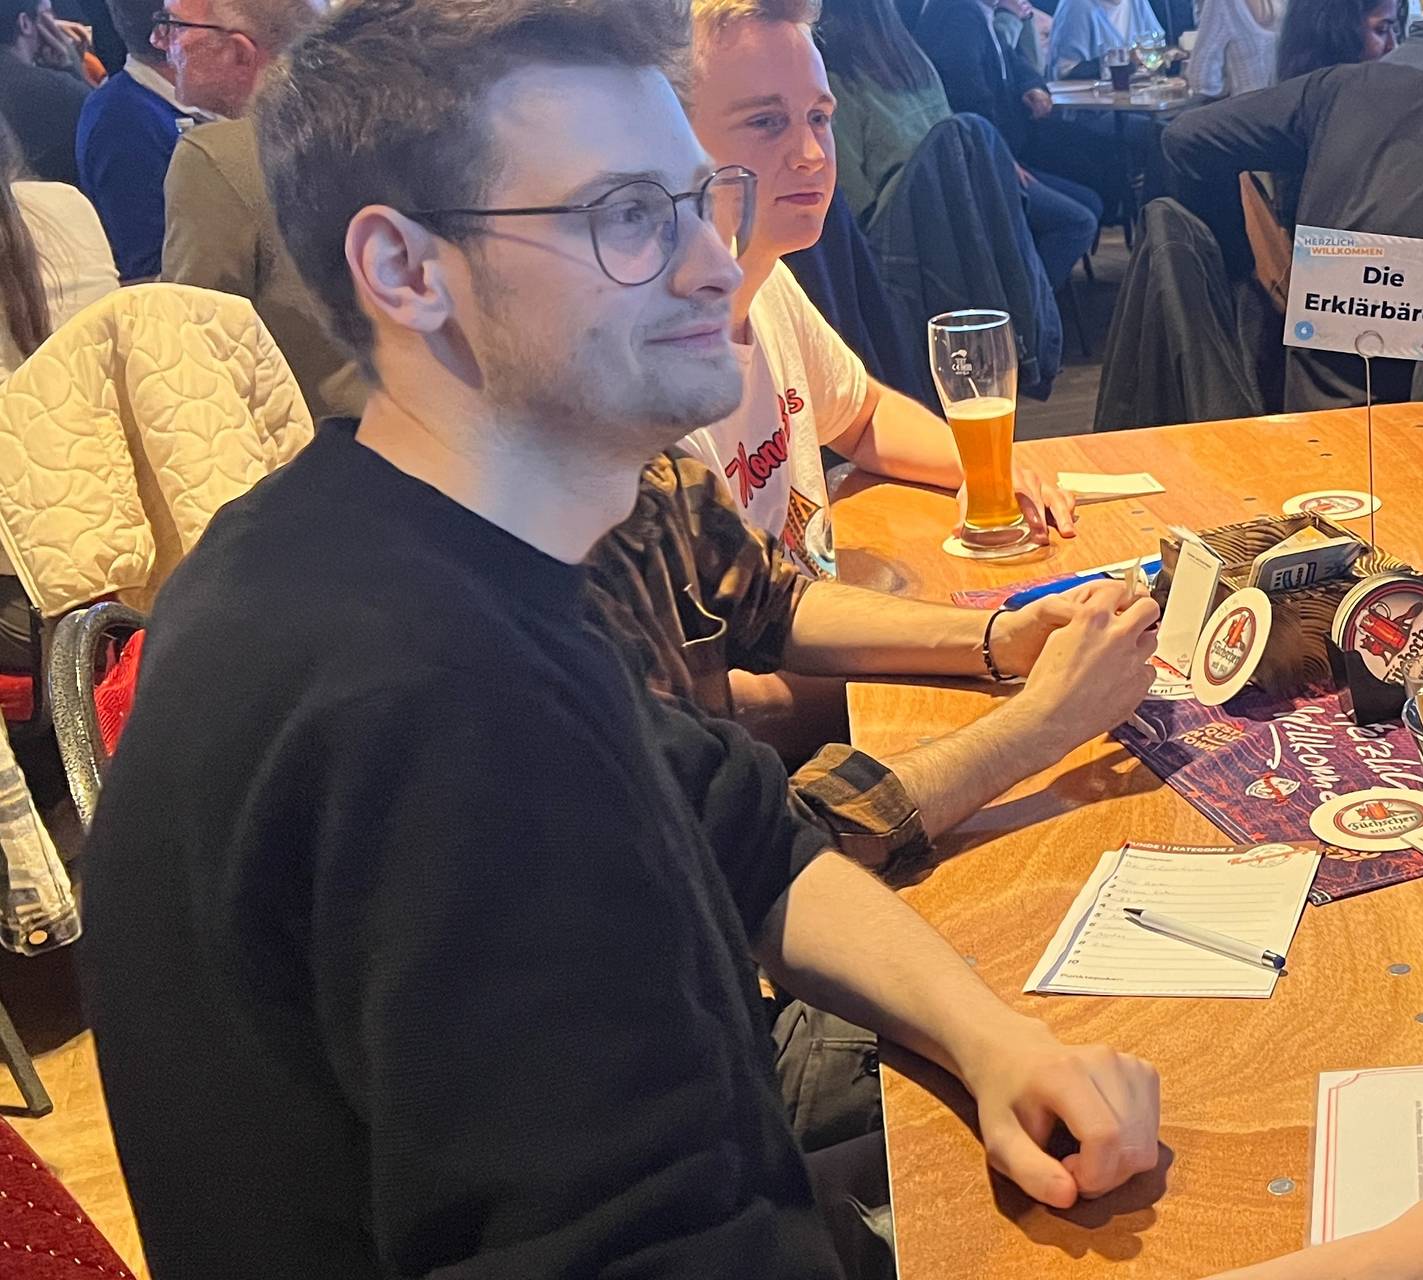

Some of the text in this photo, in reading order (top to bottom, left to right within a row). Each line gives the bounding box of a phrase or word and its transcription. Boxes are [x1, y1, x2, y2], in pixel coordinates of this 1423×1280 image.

[1304, 238, 1354, 248] HERZLICH
[1312, 247, 1383, 256] WILLKOMMEN
[1363, 266, 1404, 287] Die
[1273, 706, 1343, 802] Willkomme
[1347, 814, 1418, 831] Füchschen
